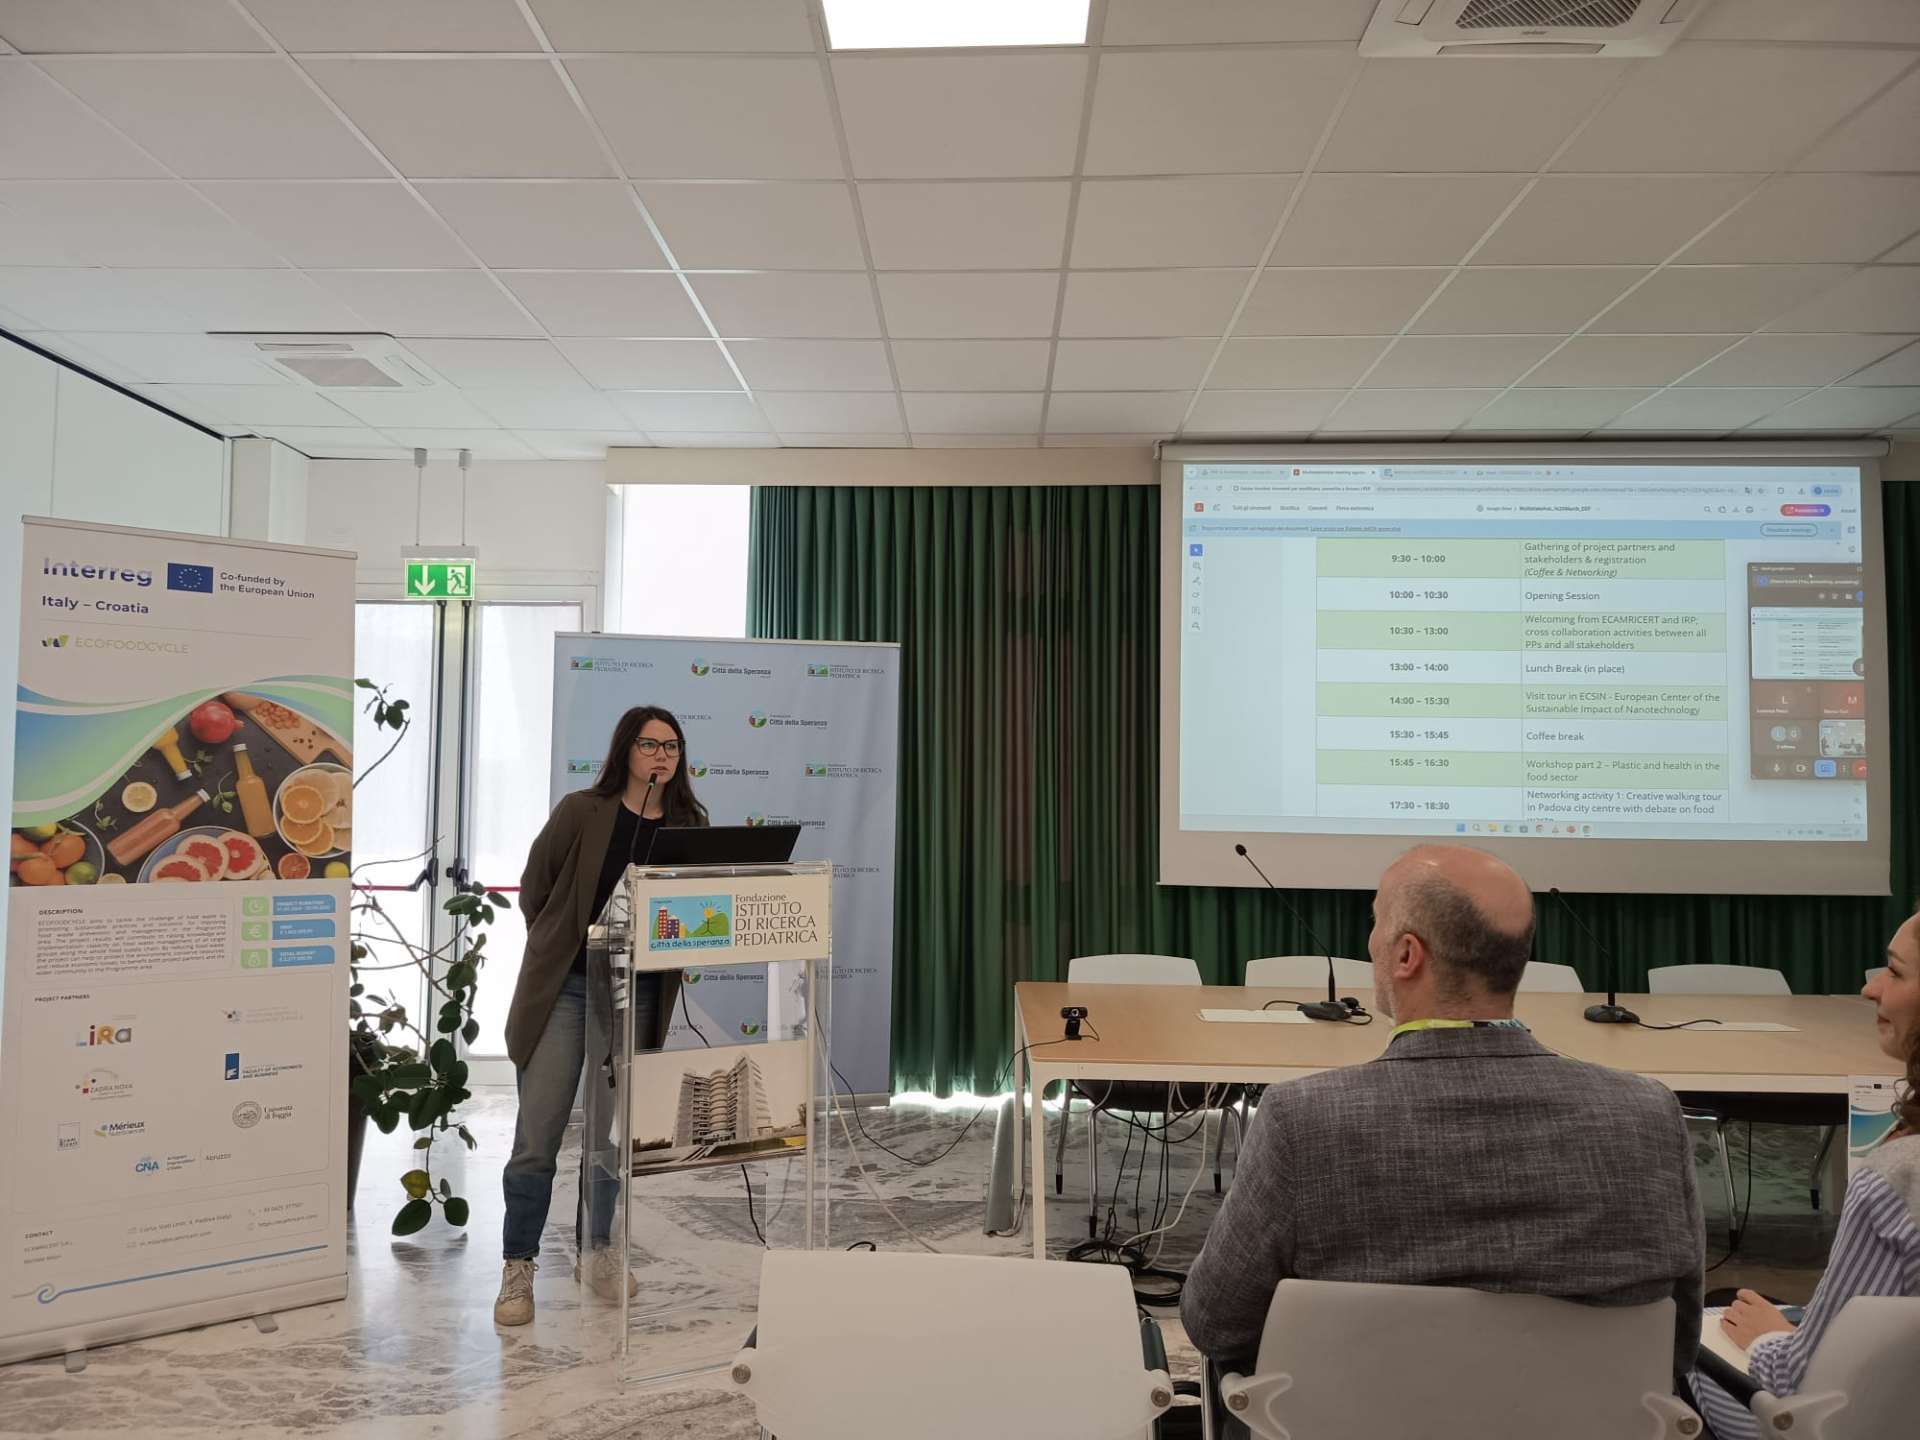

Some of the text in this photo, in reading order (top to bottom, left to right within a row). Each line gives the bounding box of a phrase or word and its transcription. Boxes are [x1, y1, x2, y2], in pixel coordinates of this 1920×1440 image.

[1524, 543, 1675, 553] Gathering of project partners and
[1391, 554, 1411, 563] 9:30
[1421, 554, 1446, 563] 10:00
[1524, 555, 1647, 566] stakeholders & registration
[43, 557, 153, 587] Interreg
[1524, 568, 1618, 578] (Coffee & Networking)
[220, 571, 286, 588] Co-funded by
[220, 583, 315, 599] the European Union
[1390, 591, 1414, 599] 10:00
[1424, 591, 1449, 599] 10:30
[1525, 592, 1600, 601] Opening Session
[42, 595, 79, 611] Italy
[95, 600, 149, 614] Croatia
[1525, 615, 1575, 625] Welcoming
[1577, 615, 1600, 624] from
[1602, 615, 1659, 624] ECAMRICERT
[1661, 616, 1679, 624] and
[1390, 626, 1414, 635] 10:30
[1424, 627, 1449, 635] 13:00
[1525, 628, 1707, 637] cross collaboration activities between all
[76, 637, 189, 654] ECOFOODCYCLE
[1525, 641, 1634, 650] PPs and all stakeholders
[1390, 663, 1414, 671] 13:00
[1424, 663, 1449, 671] 14:00
[1525, 664, 1625, 675] Lunch Break (in place)
[1390, 696, 1414, 705] 14:00
[1424, 697, 1449, 705] 15:30
[1525, 692, 1545, 700] Visit
[1547, 692, 1567, 700] tour
[1569, 692, 1577, 700] in
[1579, 692, 1607, 701] ECSIN
[1614, 693, 1659, 702] European
[1661, 693, 1691, 702] Center
[1693, 693, 1704, 702] of
[1705, 693, 1720, 702] the
[1526, 704, 1700, 716] Sustainable Impact of Nanotechnology
[1390, 730, 1415, 739] 15:30
[1424, 731, 1449, 739] 15:45
[1526, 732, 1585, 741] Coffee break
[1390, 758, 1414, 767] 15:45
[1424, 759, 1449, 767] 16:30
[1526, 760, 1573, 770] Workshop
[1575, 760, 1594, 770] part
[1596, 760, 1601, 769] 2
[1612, 761, 1642, 770] Plastic
[1643, 761, 1661, 770] and
[1663, 761, 1692, 770] health
[1694, 761, 1703, 770] in
[1705, 762, 1720, 771] the
[1526, 772, 1579, 782] food sector
[1527, 790, 1579, 801] Networking
[1581, 791, 1614, 802] activity
[1626, 792, 1664, 801] Creative
[1665, 792, 1701, 802] walking
[1390, 801, 1415, 809] 17:30
[1424, 802, 1450, 810] 18:30
[1527, 803, 1536, 812] in
[1538, 803, 1572, 812] Padova
[1573, 803, 1589, 814] city
[1591, 804, 1621, 813] centre
[1623, 804, 1643, 813] with
[1645, 804, 1677, 813] debate
[1693, 805, 1715, 814] food
[734, 893, 787, 903] Fondazione
[734, 901, 802, 917] ISTITUTO
[734, 915, 816, 931] DI RICERCA
[734, 929, 818, 947] PEDIATRICA
[672, 939, 692, 948] della
[693, 938, 730, 949] speranza
[135, 1161, 160, 1173] CNA
